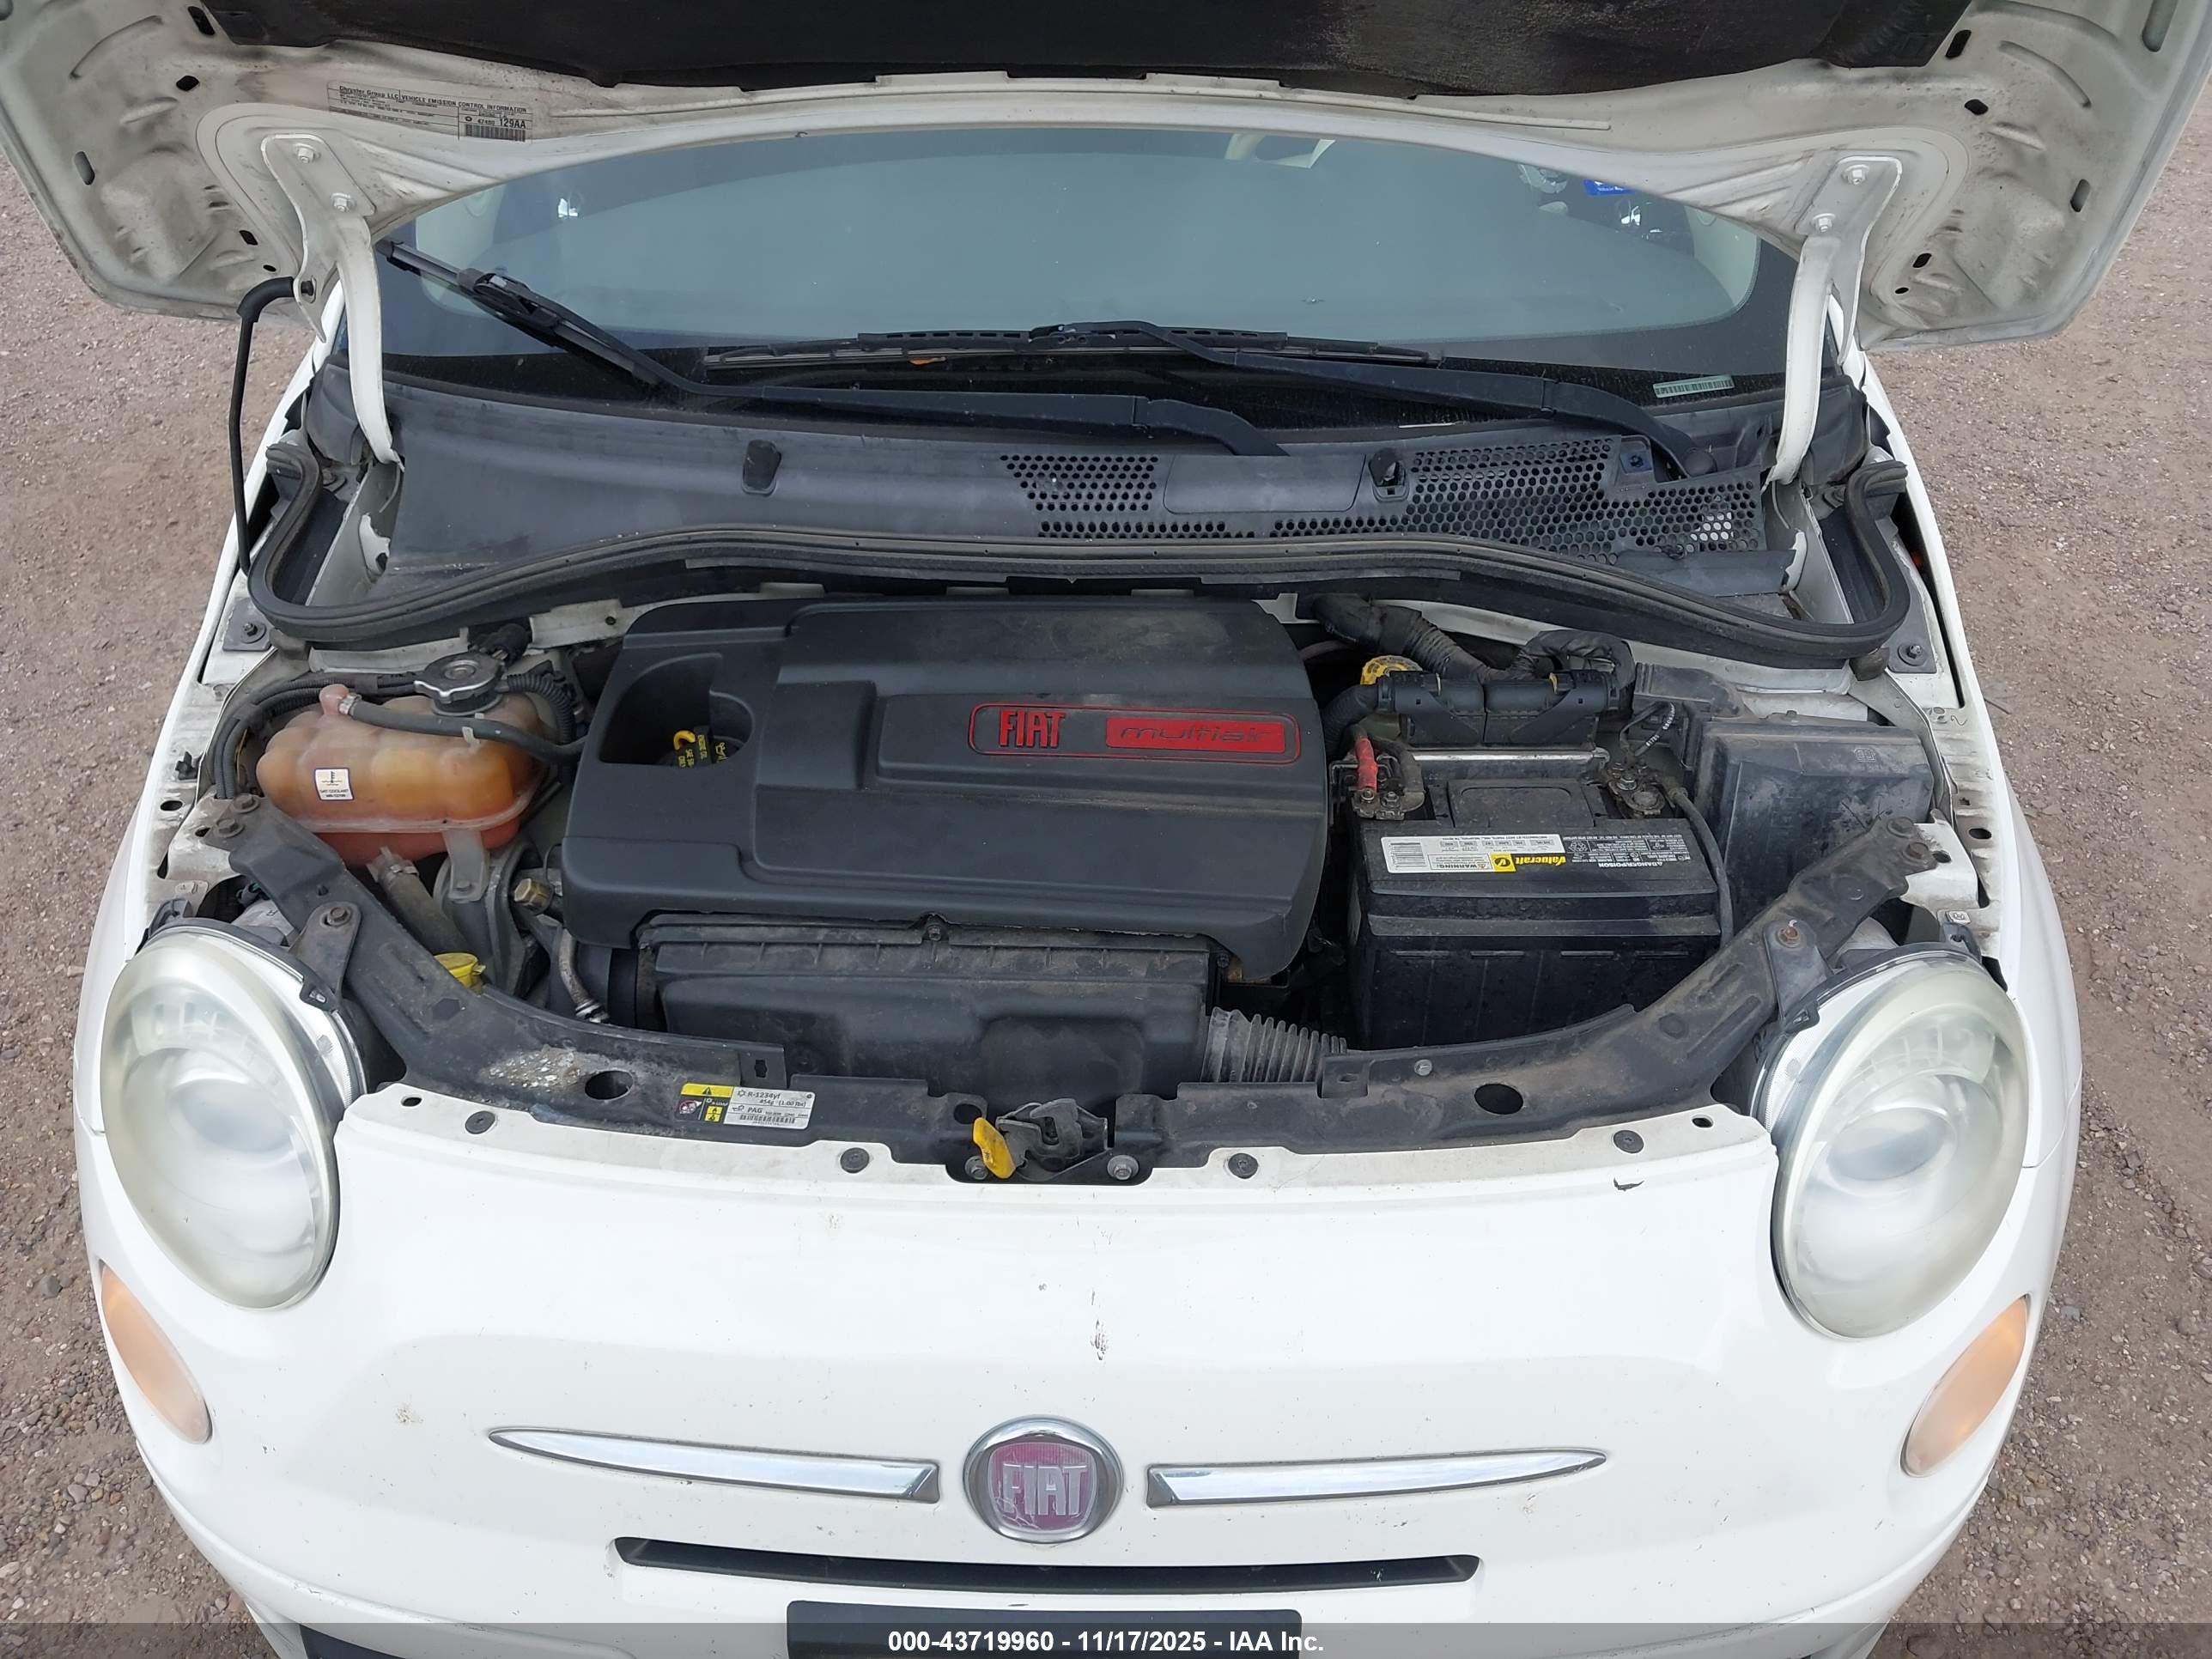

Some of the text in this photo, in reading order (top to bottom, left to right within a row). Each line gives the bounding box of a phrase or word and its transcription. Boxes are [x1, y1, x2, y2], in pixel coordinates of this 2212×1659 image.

[367, 89, 386, 98] Group
[428, 98, 457, 106] EMISSION
[486, 104, 527, 113] INFORMATION
[500, 118, 526, 129] 129AA
[998, 709, 1066, 748] FIAT
[1514, 854, 1566, 866] Valucraft
[1002, 1462, 1087, 1516] FIAT
